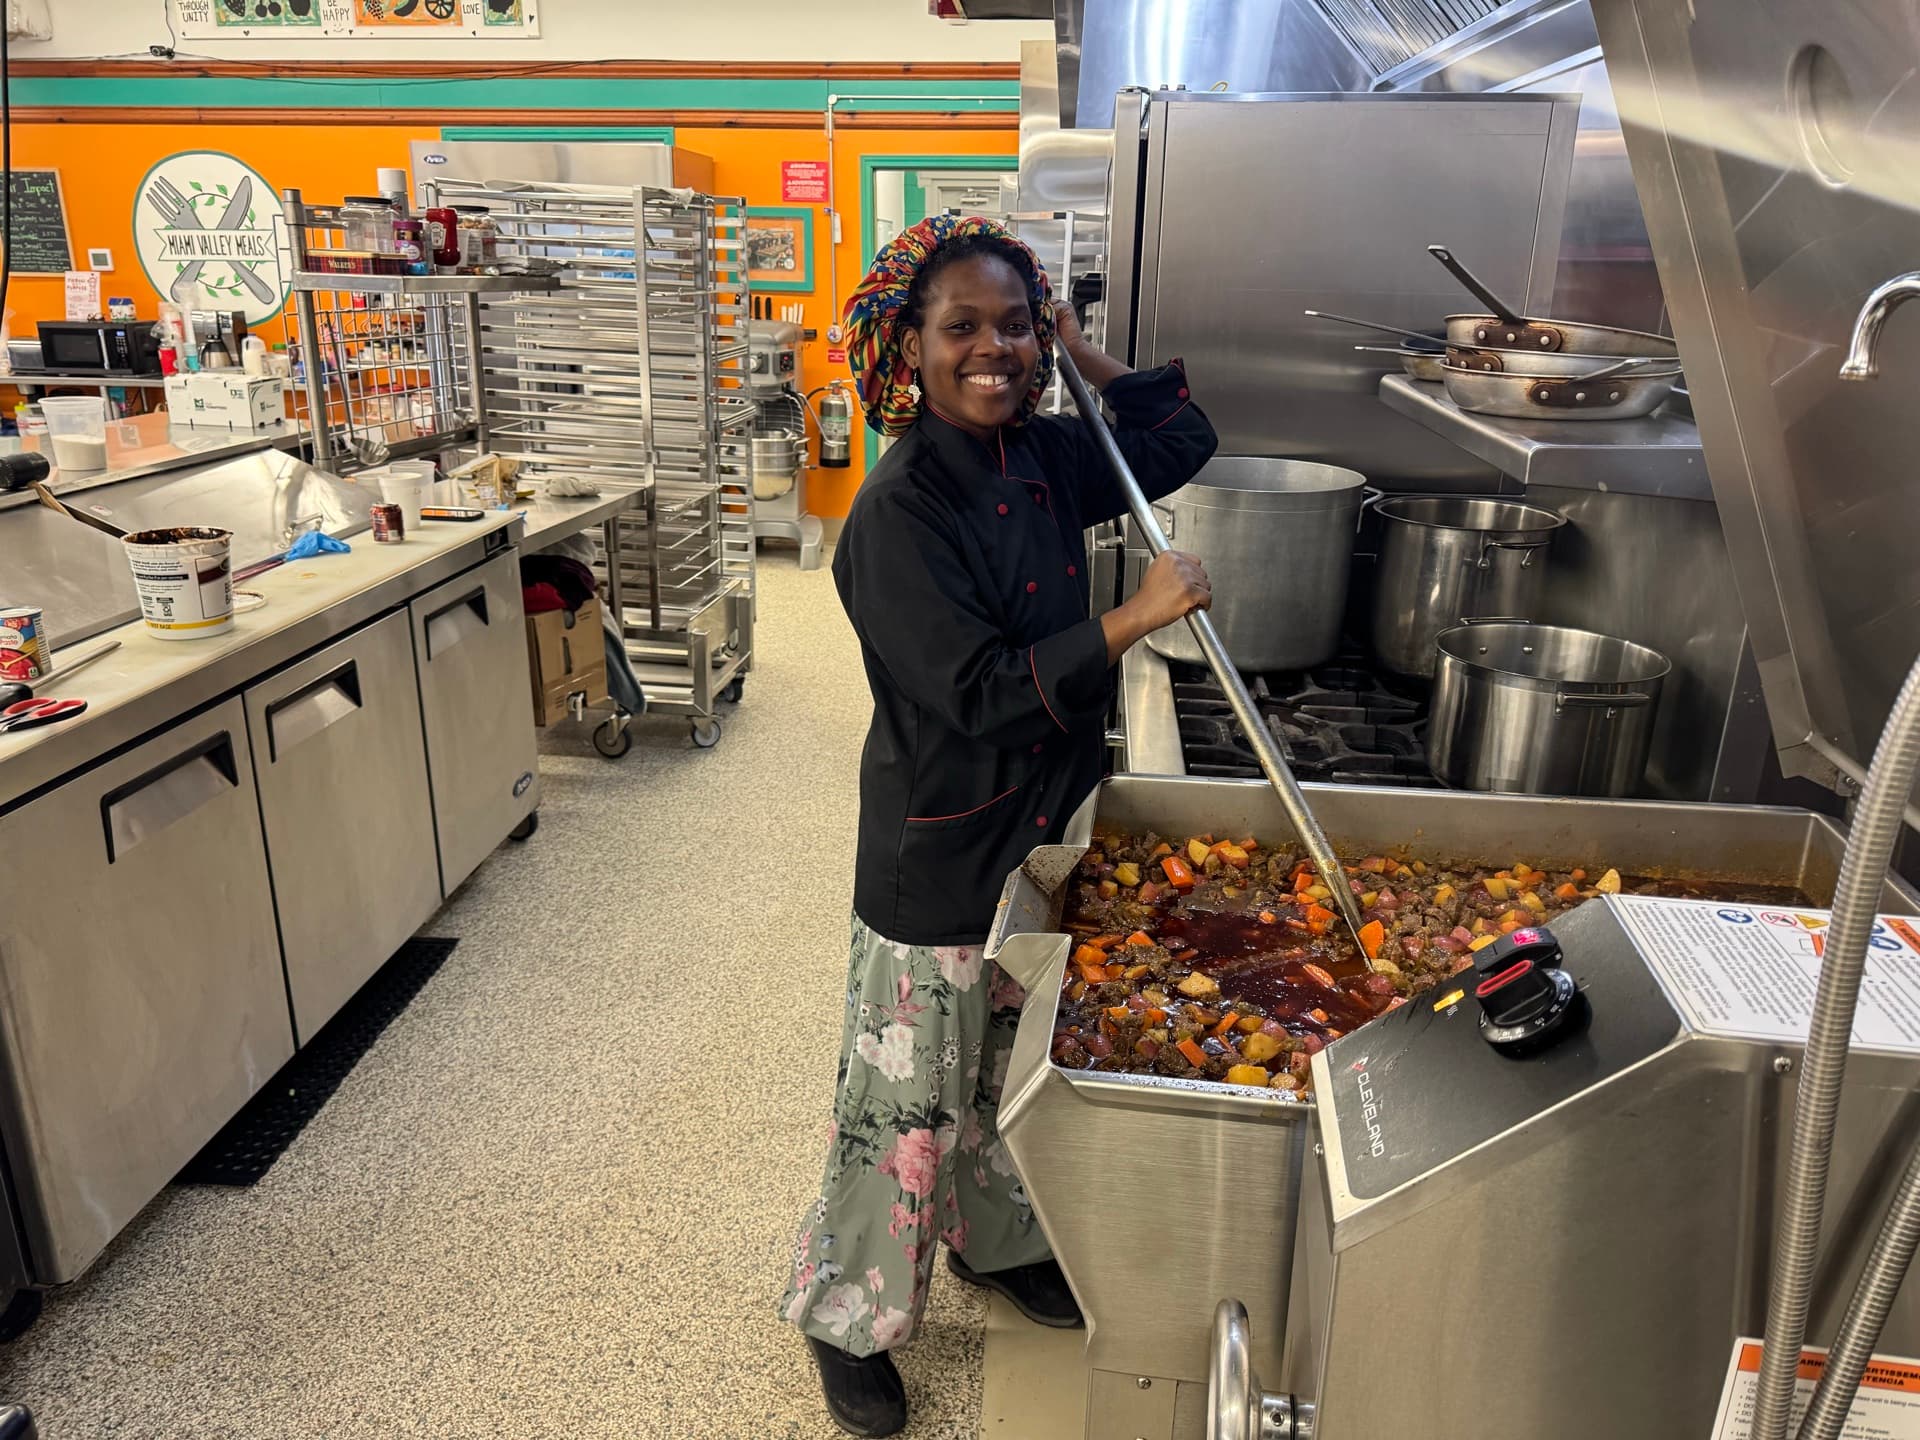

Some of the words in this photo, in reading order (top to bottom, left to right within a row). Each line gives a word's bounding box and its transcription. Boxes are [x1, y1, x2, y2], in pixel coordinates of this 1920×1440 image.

[323, 8, 350, 21] HAPPY
[463, 3, 481, 15] LOVE
[183, 12, 209, 22] UNITY
[167, 235, 195, 255] MIAMI
[196, 235, 233, 256] VALLEY
[235, 235, 265, 256] MEALS
[1358, 1072, 1385, 1158] CLEVELAND
